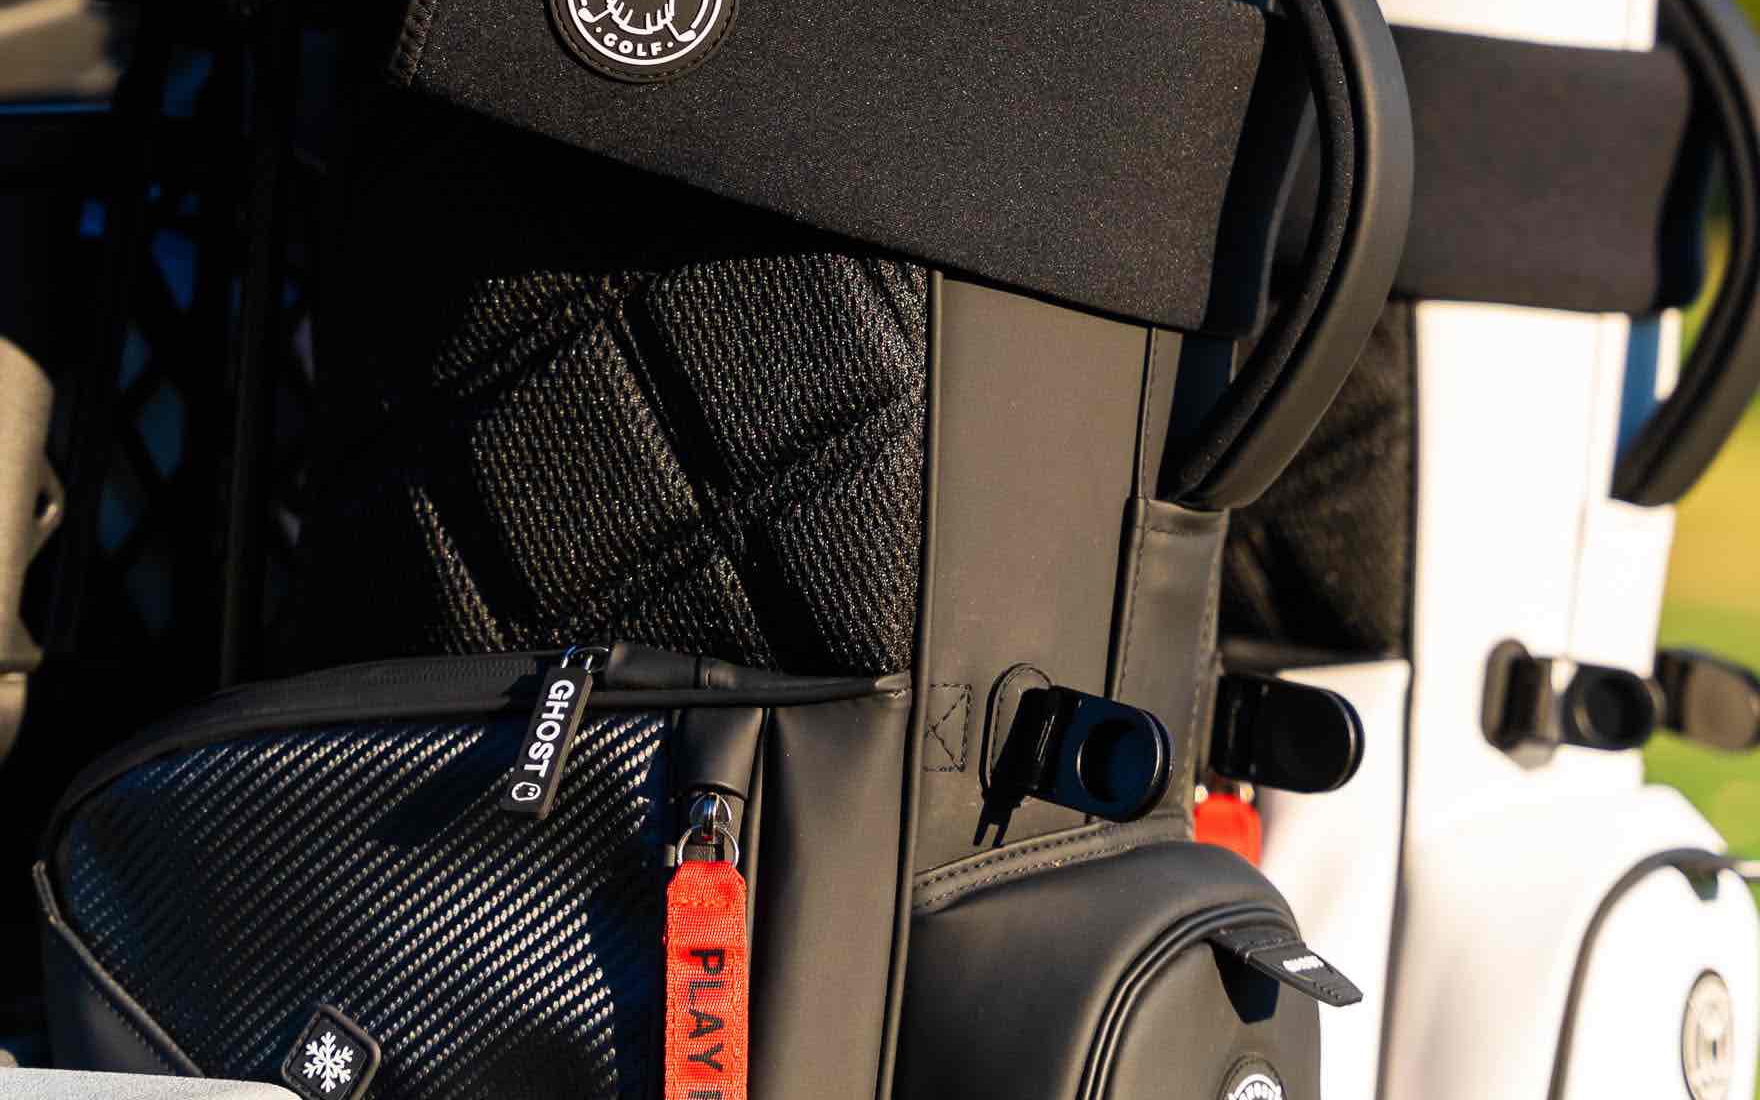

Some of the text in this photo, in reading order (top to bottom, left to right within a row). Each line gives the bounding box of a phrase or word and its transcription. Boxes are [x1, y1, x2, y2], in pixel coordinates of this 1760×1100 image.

[603, 33, 662, 56] GOLF
[523, 679, 575, 778] GHOST
[688, 949, 724, 1072] PLAY
